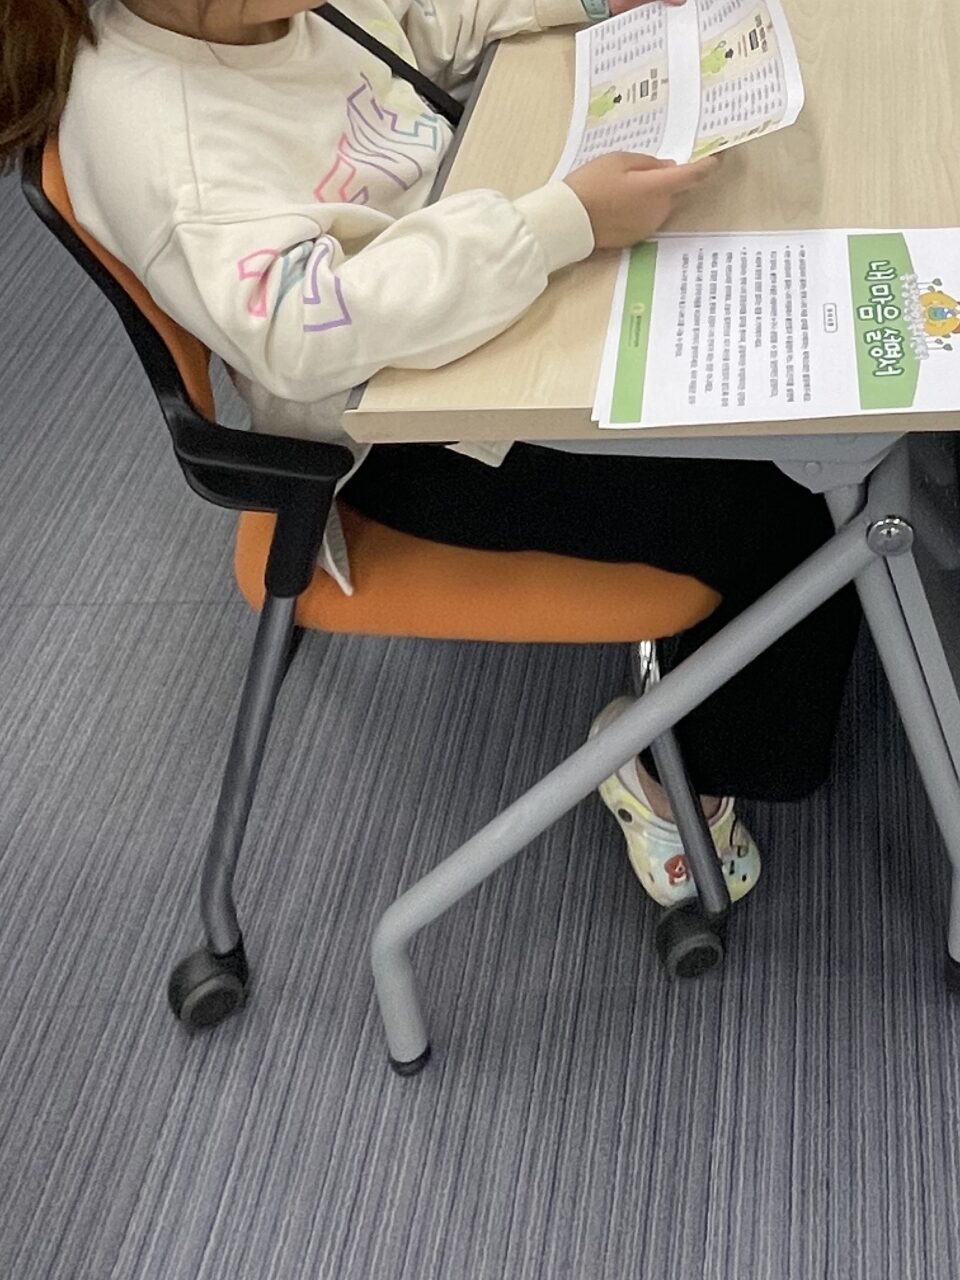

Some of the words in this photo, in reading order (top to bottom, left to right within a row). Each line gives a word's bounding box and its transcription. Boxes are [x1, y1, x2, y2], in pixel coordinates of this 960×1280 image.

[865, 260, 897, 282] 내
[857, 283, 901, 324] 마음
[864, 328, 905, 377] 설명서
